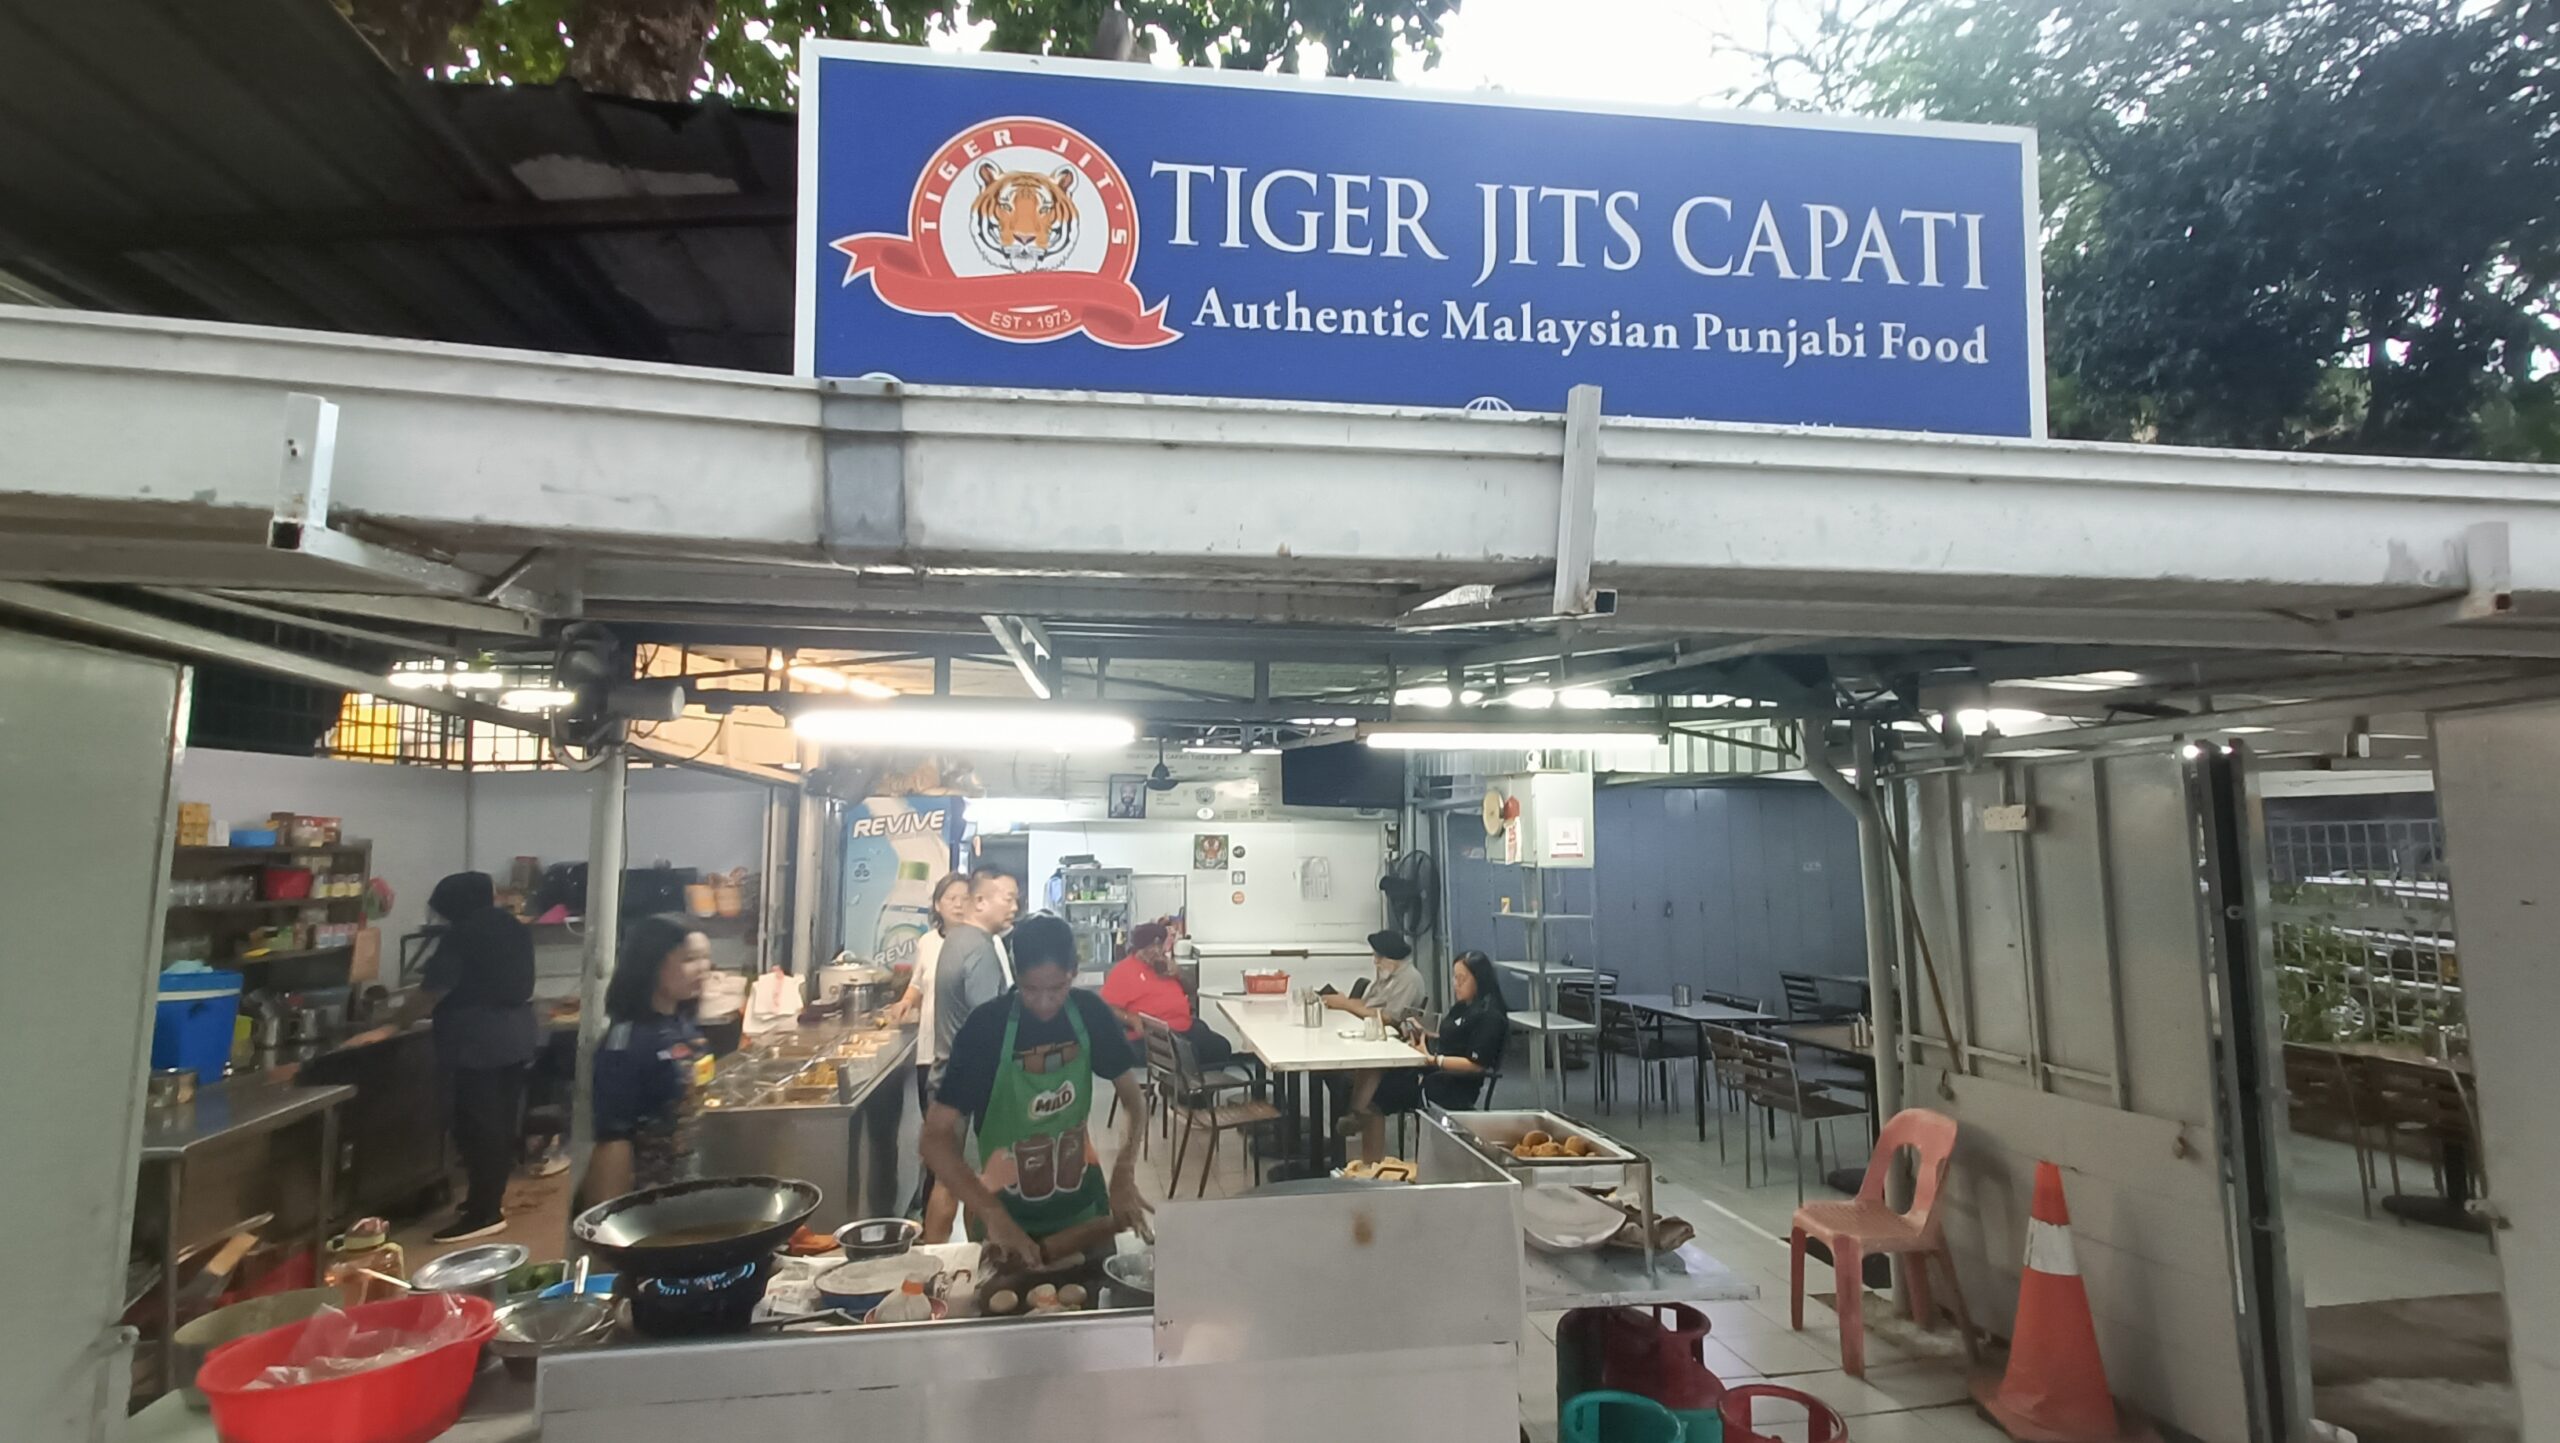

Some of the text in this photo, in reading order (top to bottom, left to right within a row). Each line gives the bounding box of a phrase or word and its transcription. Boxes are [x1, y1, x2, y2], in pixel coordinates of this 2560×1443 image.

[920, 129, 1128, 246] TIGER JIT'S
[1150, 160, 1990, 291] TIGER JITS CAPATI
[989, 309, 1073, 329] EST 1973
[1191, 286, 1990, 369] Authentic Malaysian Punjabi Food
[852, 809, 945, 838] REVIVE
[873, 939, 918, 967] REVI
